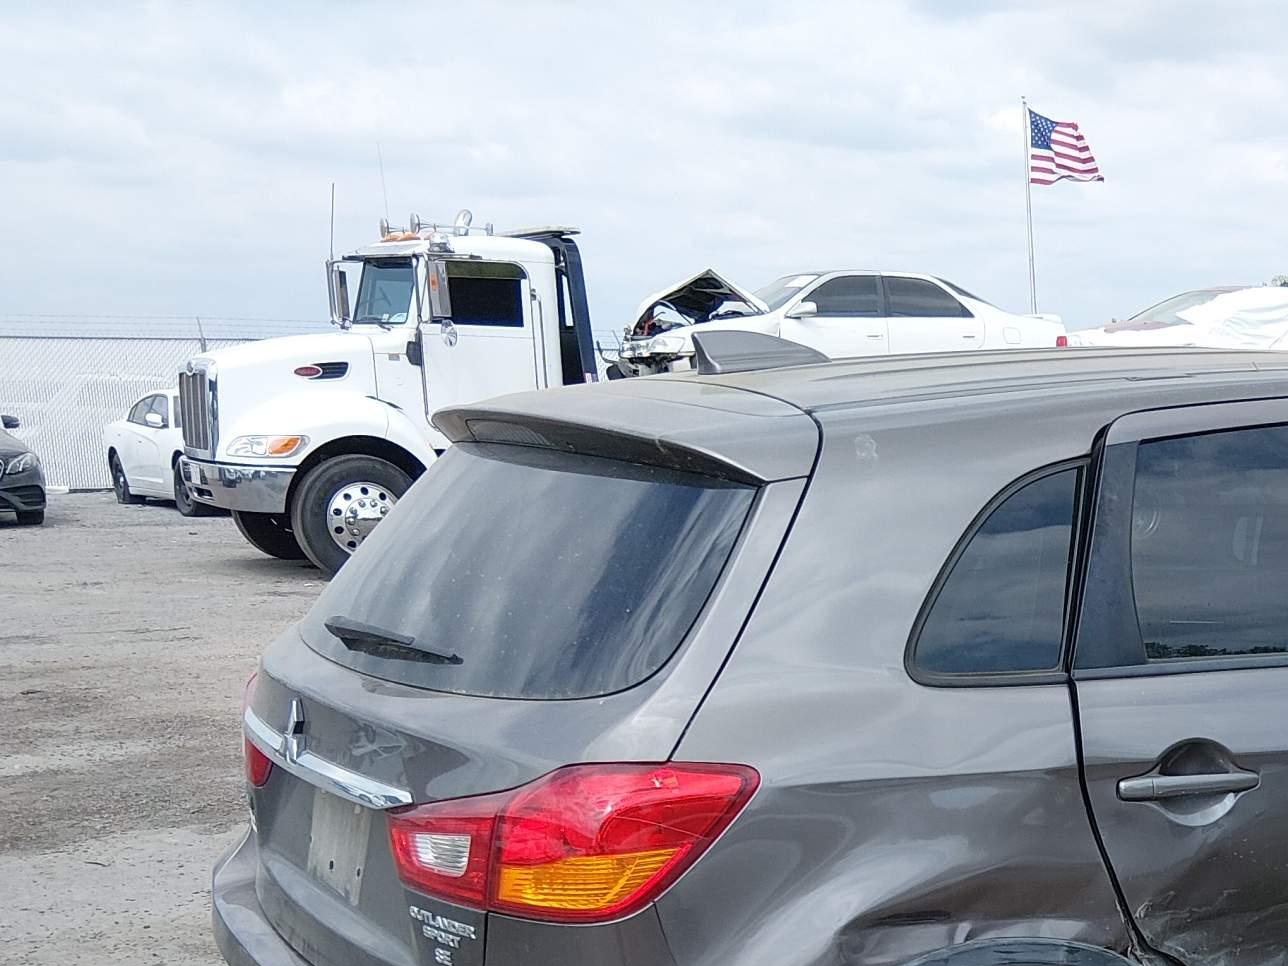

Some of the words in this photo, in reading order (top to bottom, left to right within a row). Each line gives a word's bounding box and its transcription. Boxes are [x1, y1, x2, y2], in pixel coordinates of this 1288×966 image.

[409, 905, 476, 940] OUTLANDER
[422, 925, 461, 949] SPORT
[434, 947, 454, 966] SE
